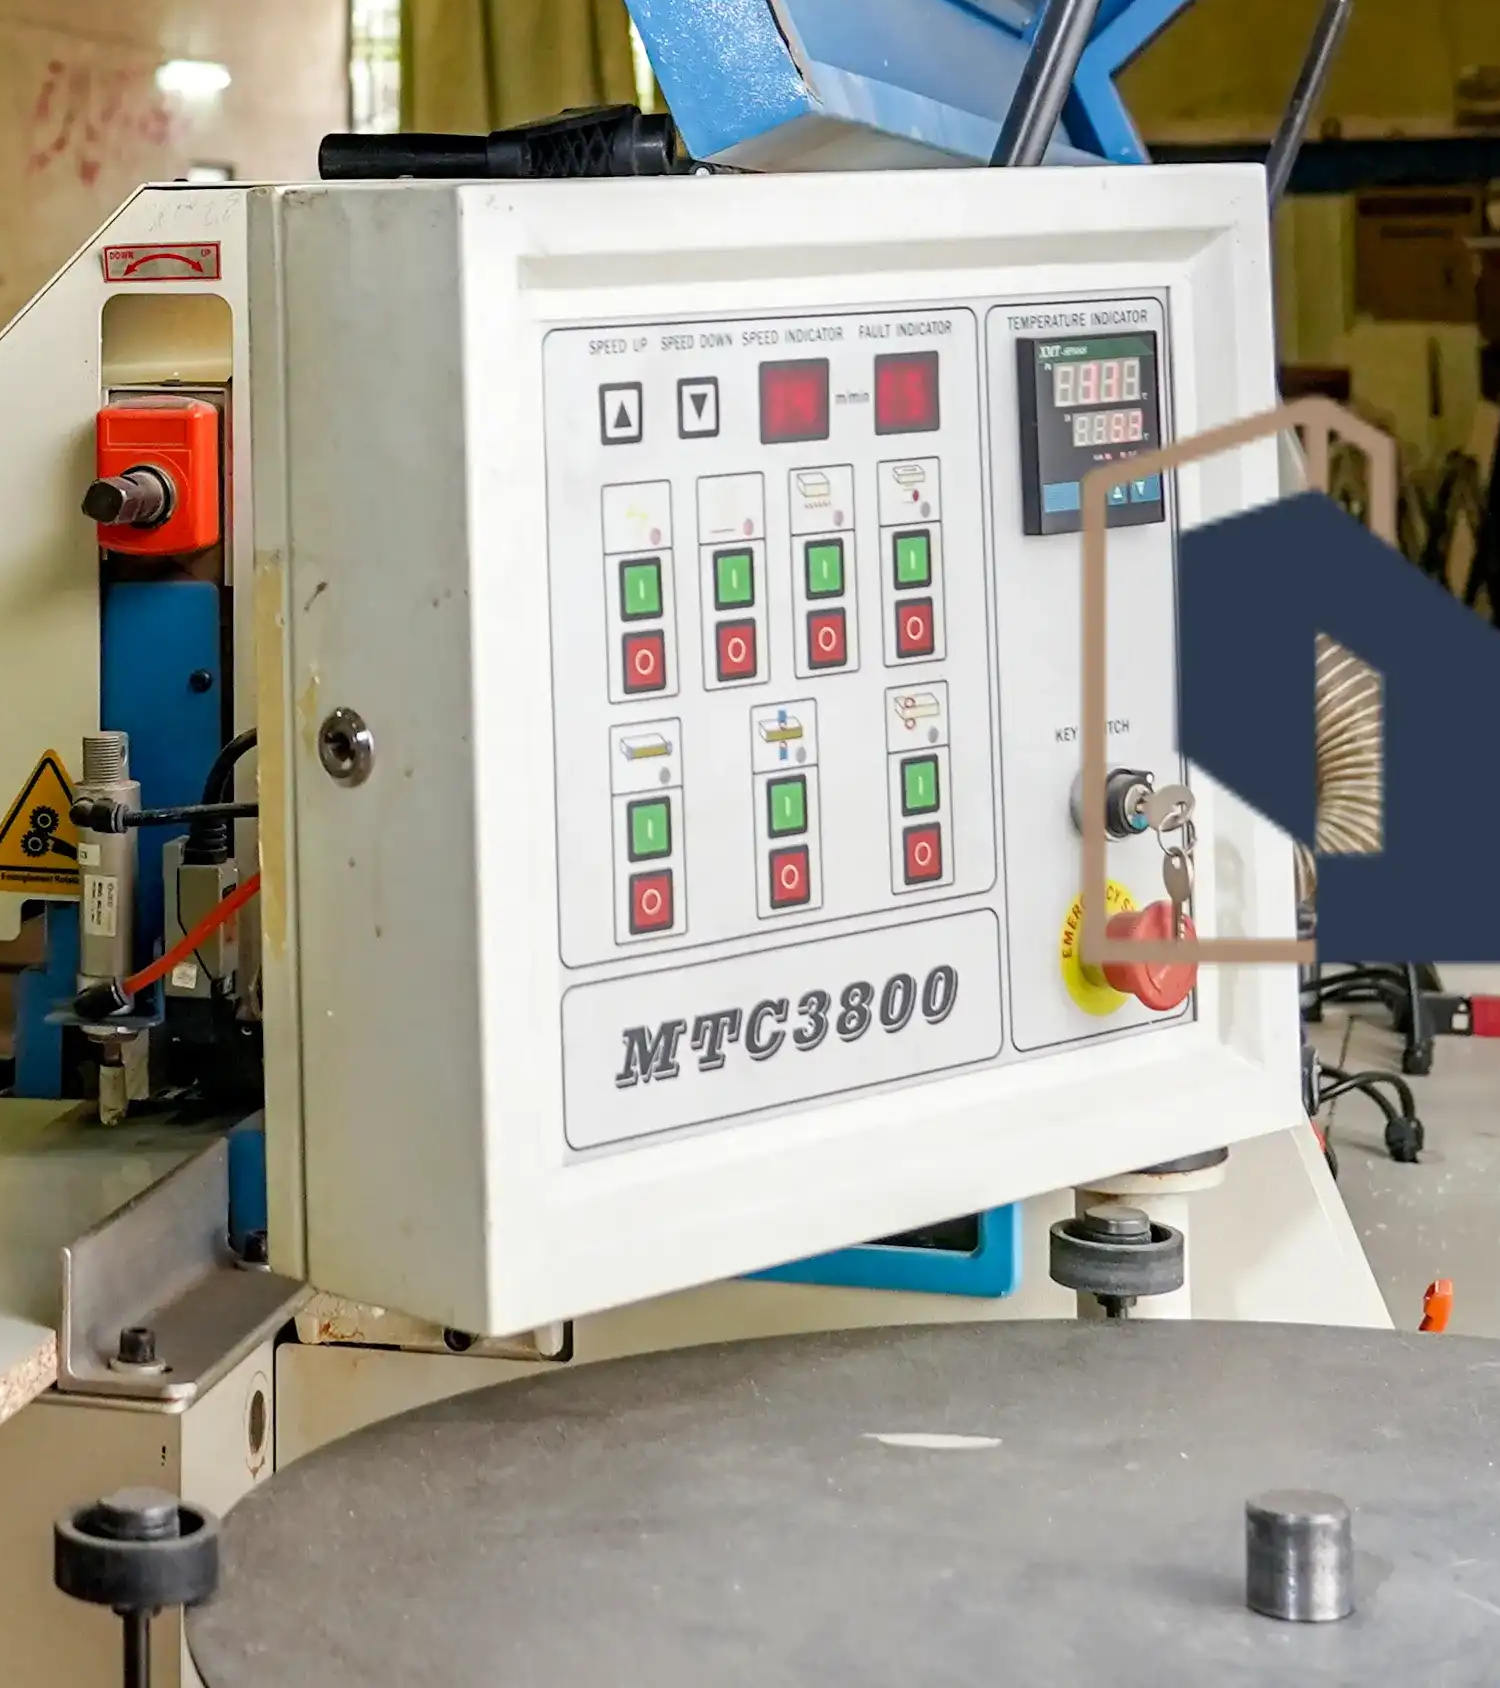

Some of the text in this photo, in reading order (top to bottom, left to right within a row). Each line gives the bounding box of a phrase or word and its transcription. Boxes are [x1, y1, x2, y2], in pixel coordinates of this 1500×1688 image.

[109, 248, 212, 260] DOWN UP
[858, 319, 953, 339] FAULT INDICATOR
[1007, 309, 1148, 330] TEMPERATURE INDICATOR
[660, 332, 733, 351] SPEED DOWN
[742, 325, 844, 346] SPEED INDICATOR
[588, 337, 648, 355] SPEED UP
[1055, 725, 1078, 742] KEY
[614, 964, 960, 1089] MTC3800
